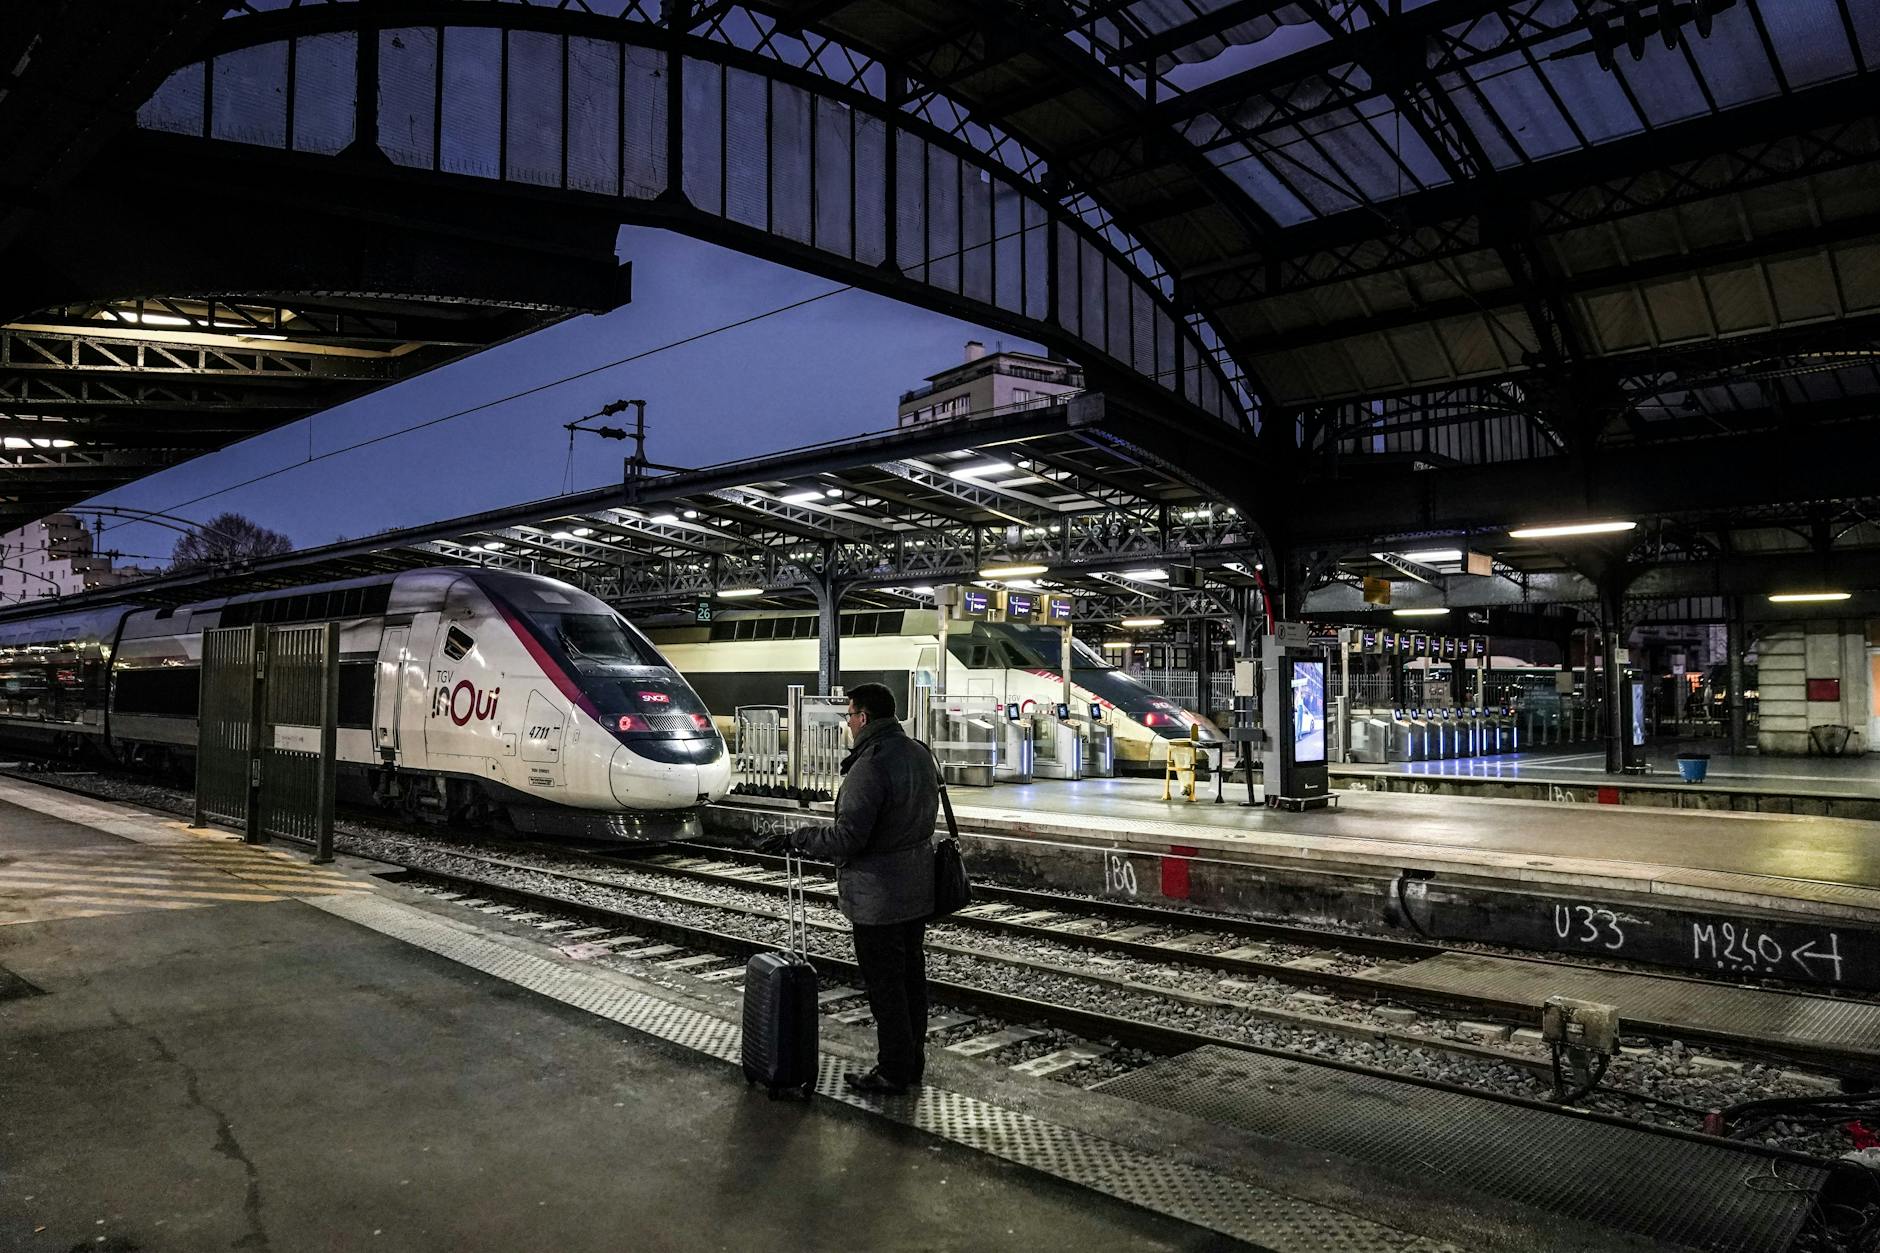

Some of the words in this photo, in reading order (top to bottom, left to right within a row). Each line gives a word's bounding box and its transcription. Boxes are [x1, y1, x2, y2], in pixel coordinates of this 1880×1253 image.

[697, 608, 711, 619] 26
[436, 671, 455, 683] TGV
[529, 726, 550, 739] 4711
[1555, 904, 1624, 949] U33
